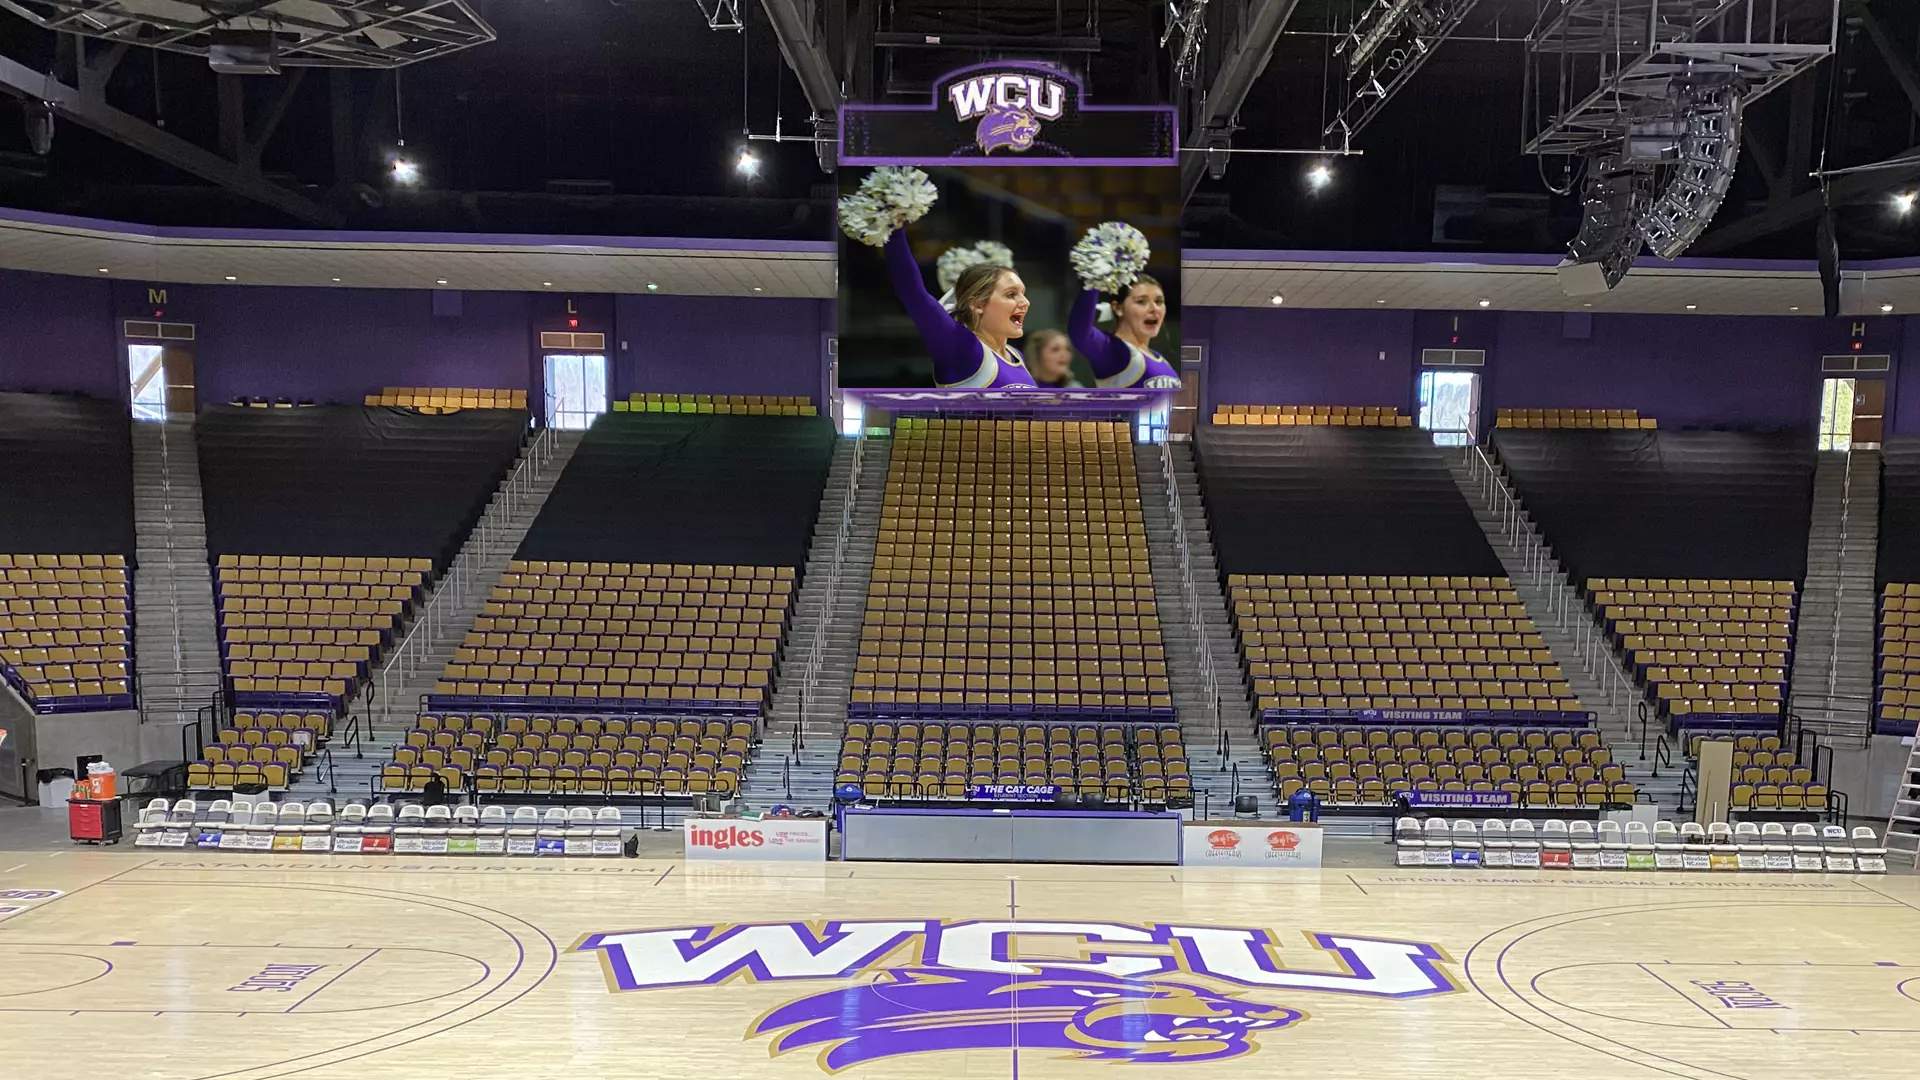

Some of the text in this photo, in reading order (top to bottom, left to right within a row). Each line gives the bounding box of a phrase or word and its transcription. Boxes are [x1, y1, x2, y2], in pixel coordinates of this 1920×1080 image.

[949, 73, 1065, 122] WCU
[148, 288, 167, 304] M
[567, 298, 577, 314] L
[1851, 321, 1866, 337] H
[1382, 710, 1431, 720] VISITING
[1433, 711, 1463, 720] TEAM
[984, 785, 1004, 794] THE
[1005, 785, 1026, 794] CAT
[1026, 785, 1054, 794] CAGE
[1419, 793, 1473, 803] VISITING
[1475, 794, 1508, 804] TEAM
[690, 824, 765, 850] ingles
[1561, 879, 1661, 887] REGIONAL
[1668, 880, 1752, 888] ACTIVITY
[564, 918, 1469, 999] WCU
